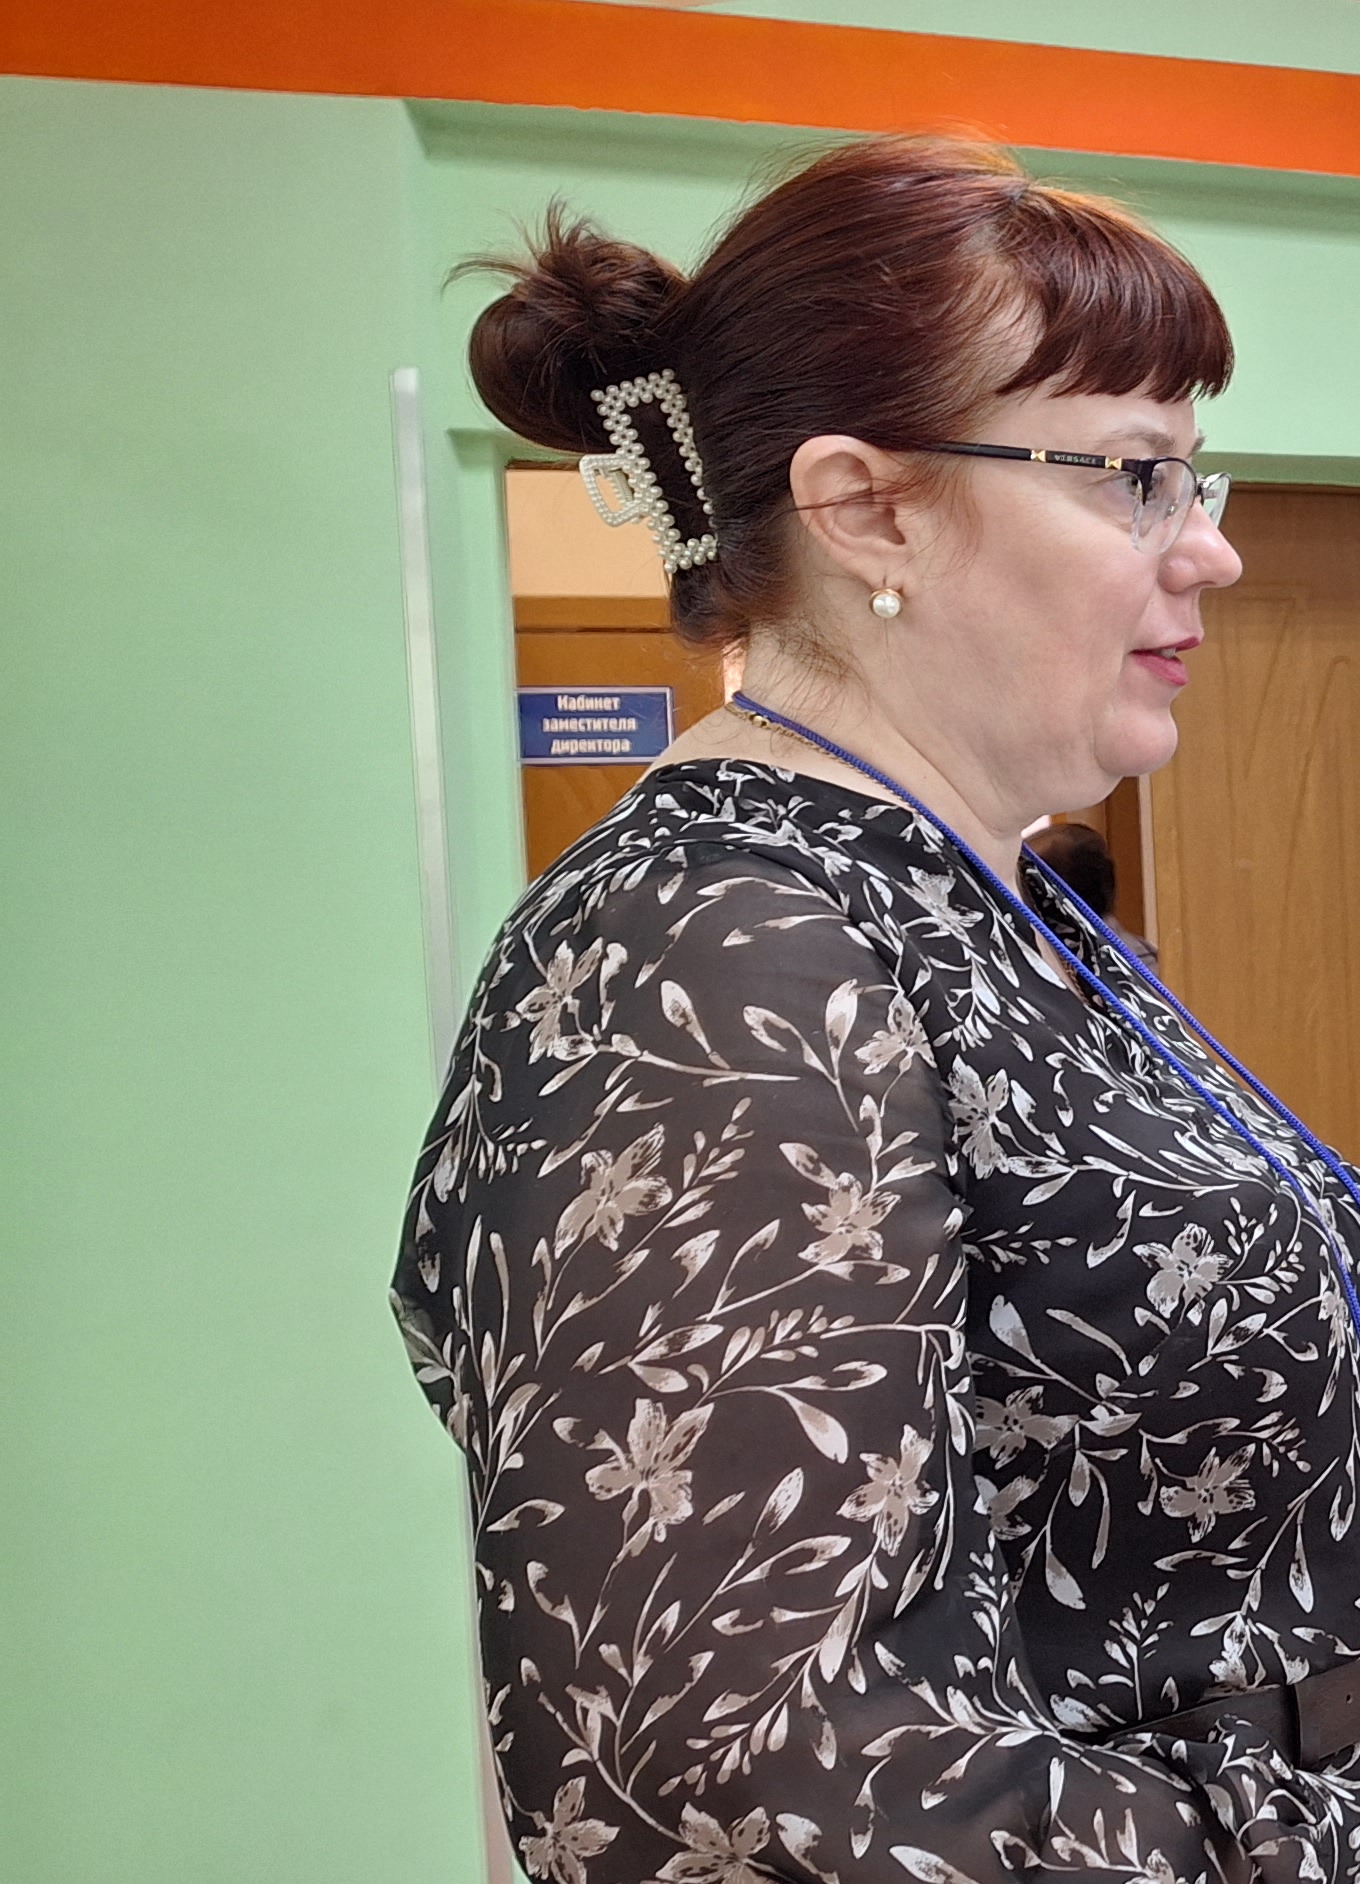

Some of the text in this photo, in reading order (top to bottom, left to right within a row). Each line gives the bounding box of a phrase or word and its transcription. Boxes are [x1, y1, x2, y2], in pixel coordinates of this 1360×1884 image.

[557, 695, 621, 711] Кабинет
[543, 718, 638, 732] заместителя
[551, 739, 631, 754] директора
